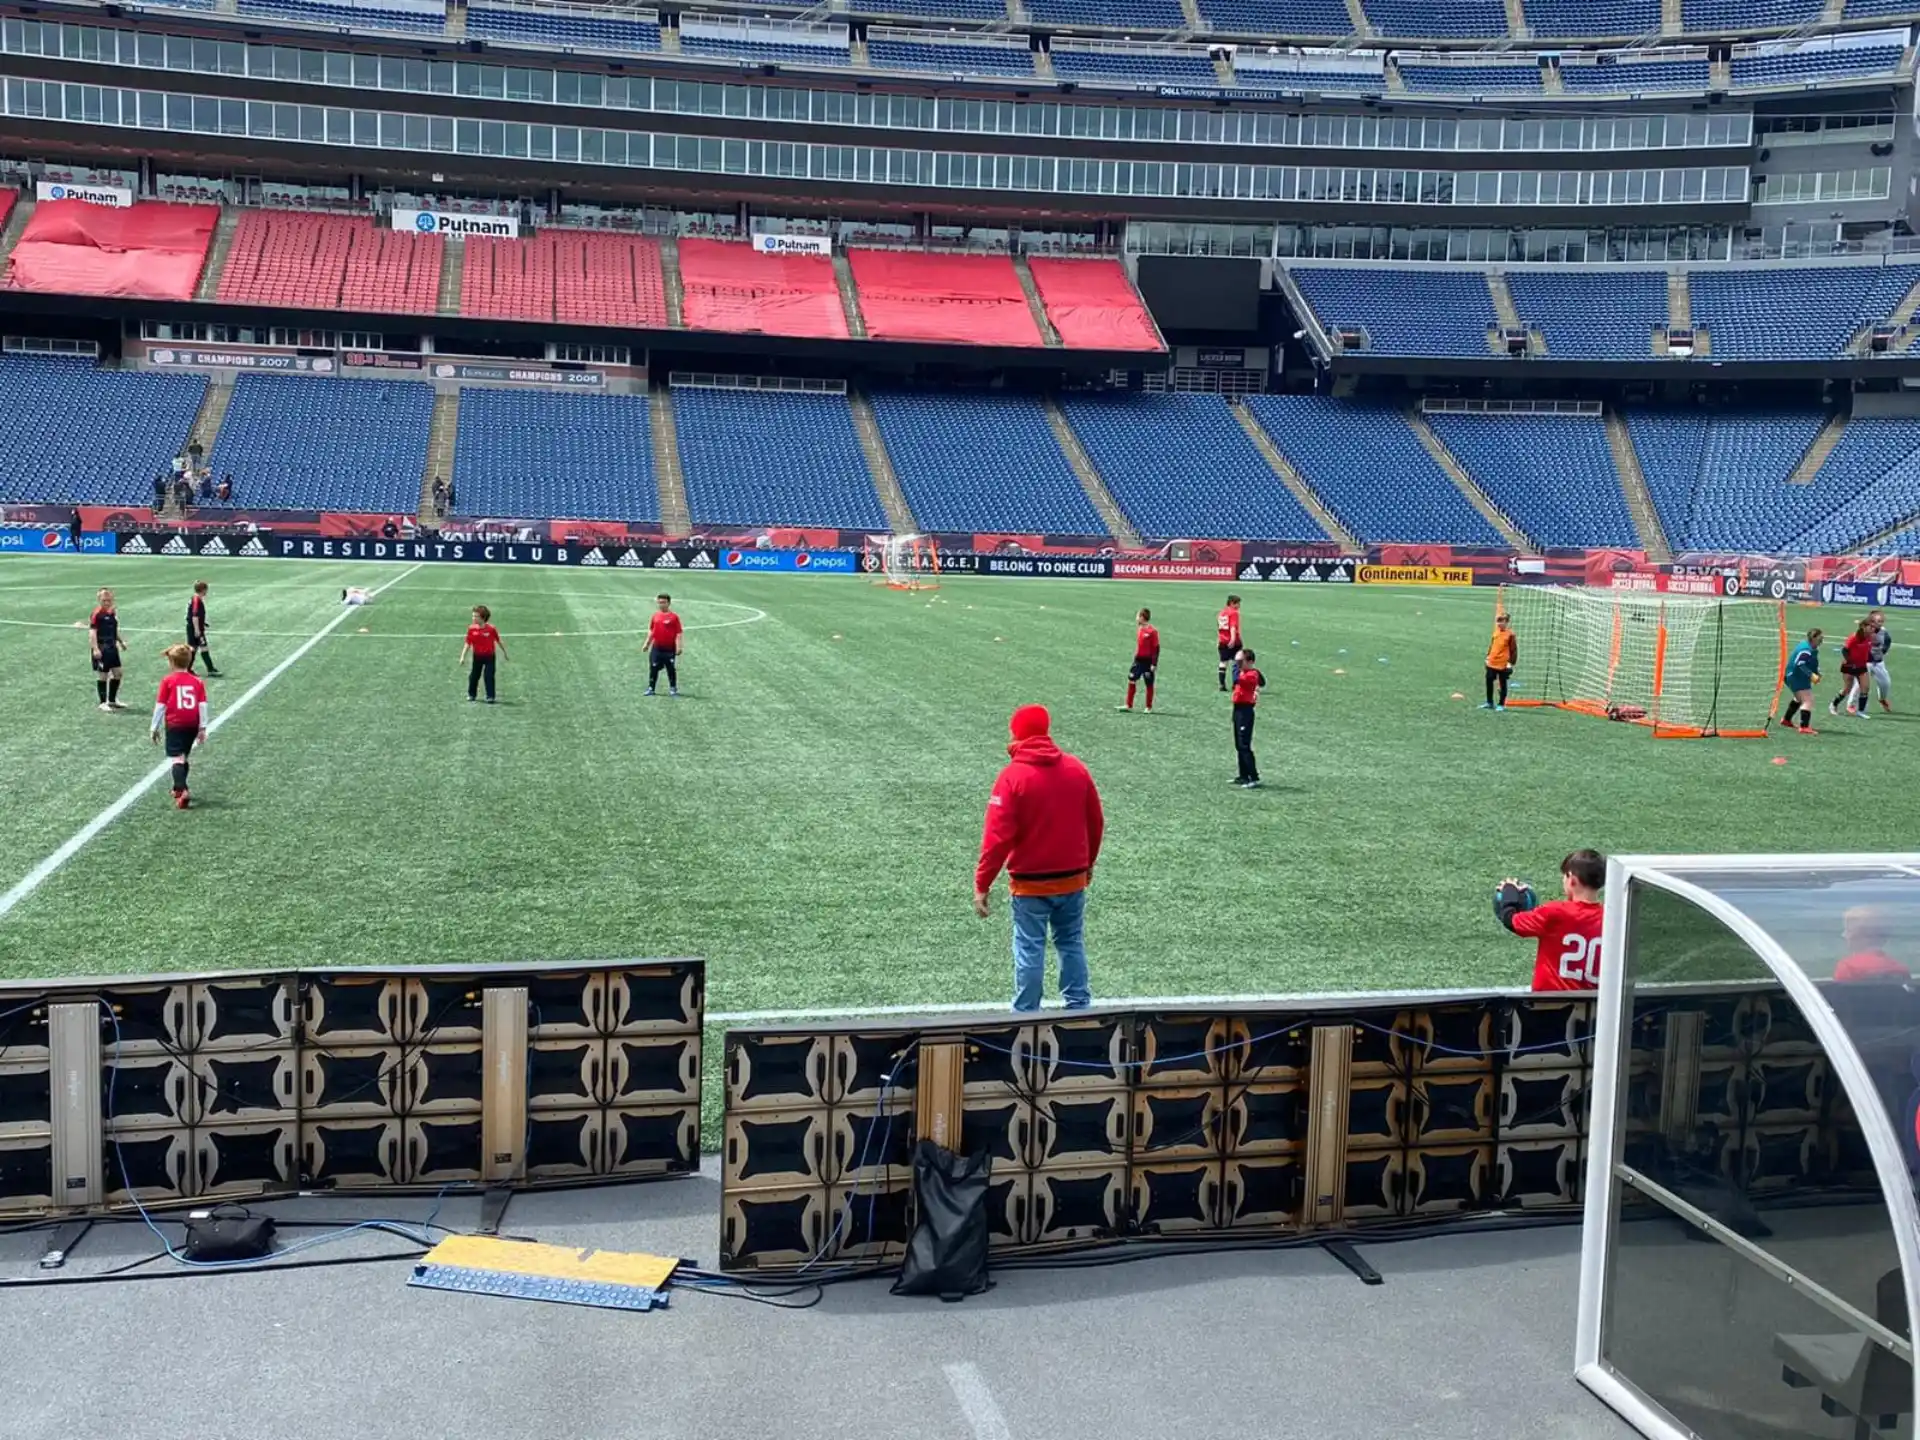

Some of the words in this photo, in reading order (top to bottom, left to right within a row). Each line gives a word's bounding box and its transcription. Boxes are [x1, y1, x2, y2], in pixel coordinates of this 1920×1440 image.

[67, 188, 118, 203] Putnam
[439, 216, 510, 235] Putnam
[777, 239, 820, 251] Putnam
[197, 354, 255, 367] CHAMPIONS
[260, 357, 290, 368] 2007
[509, 370, 563, 382] CHAMPIONS
[121, 545, 152, 554] adidas
[160, 546, 191, 555] adidas
[199, 547, 230, 556] adidas
[238, 547, 269, 557] adidas
[283, 539, 464, 559] PRESIDENTS
[484, 546, 568, 562] CLUB
[581, 557, 608, 566] adidas
[616, 557, 644, 567] adidas
[653, 559, 681, 569] adidas
[688, 560, 715, 569] adidas
[744, 554, 779, 567] pepsi
[813, 555, 847, 568] pepsi
[990, 559, 1033, 573] BELONG
[1037, 562, 1052, 573] TO
[1053, 562, 1077, 574] ONE
[1077, 563, 1105, 574] CLUB
[1114, 564, 1150, 575] BECOME
[1151, 565, 1159, 575] A
[1159, 566, 1194, 576] SEASON
[1195, 566, 1232, 576] MEMBER
[1359, 566, 1429, 583] Continental
[1443, 572, 1469, 582] TIRE
[1834, 582, 1856, 593] United
[1890, 586, 1914, 597] United
[1834, 593, 1868, 603] Healthcare
[176, 685, 196, 710] 15
[1559, 932, 1602, 985] 20
